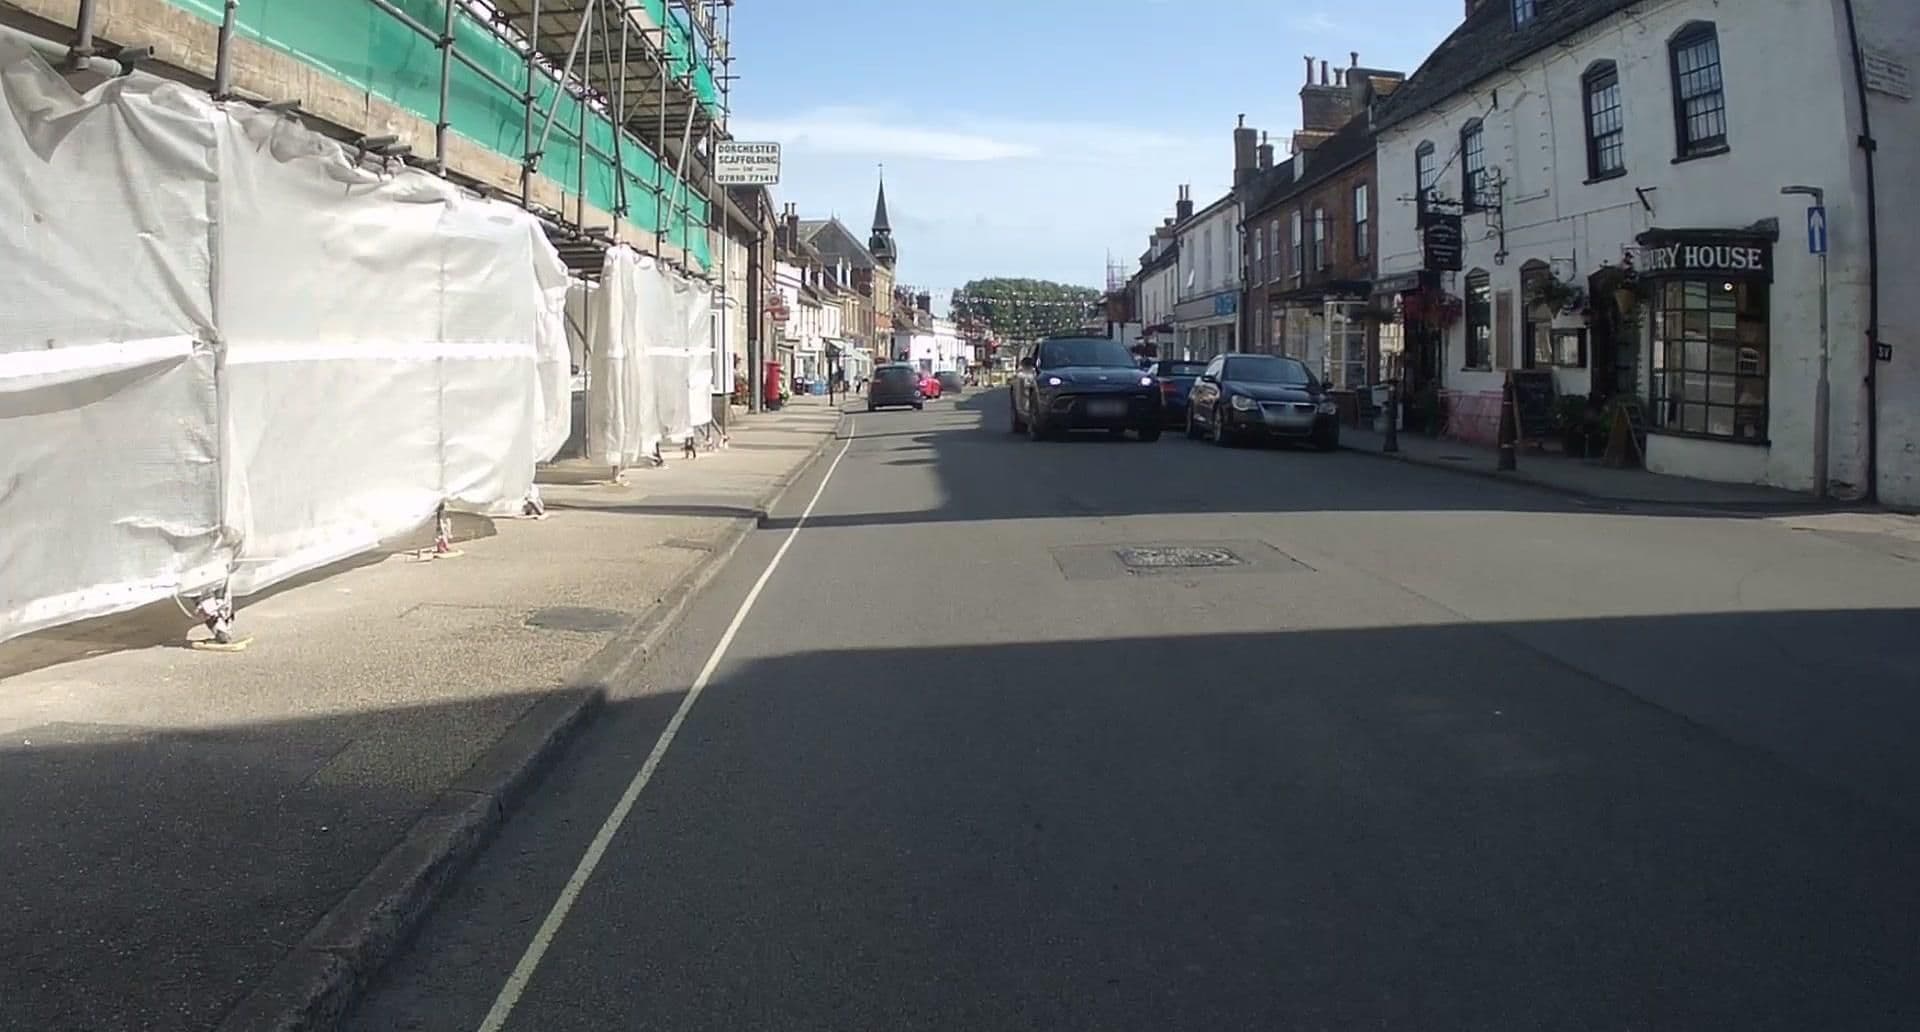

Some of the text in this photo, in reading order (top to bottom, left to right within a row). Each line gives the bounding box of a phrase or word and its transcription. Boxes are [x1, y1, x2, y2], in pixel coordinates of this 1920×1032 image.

[718, 145, 777, 154] DORCHESTER
[718, 155, 777, 164] SCAFFOLDING
[1684, 246, 1763, 269] HOUSE
